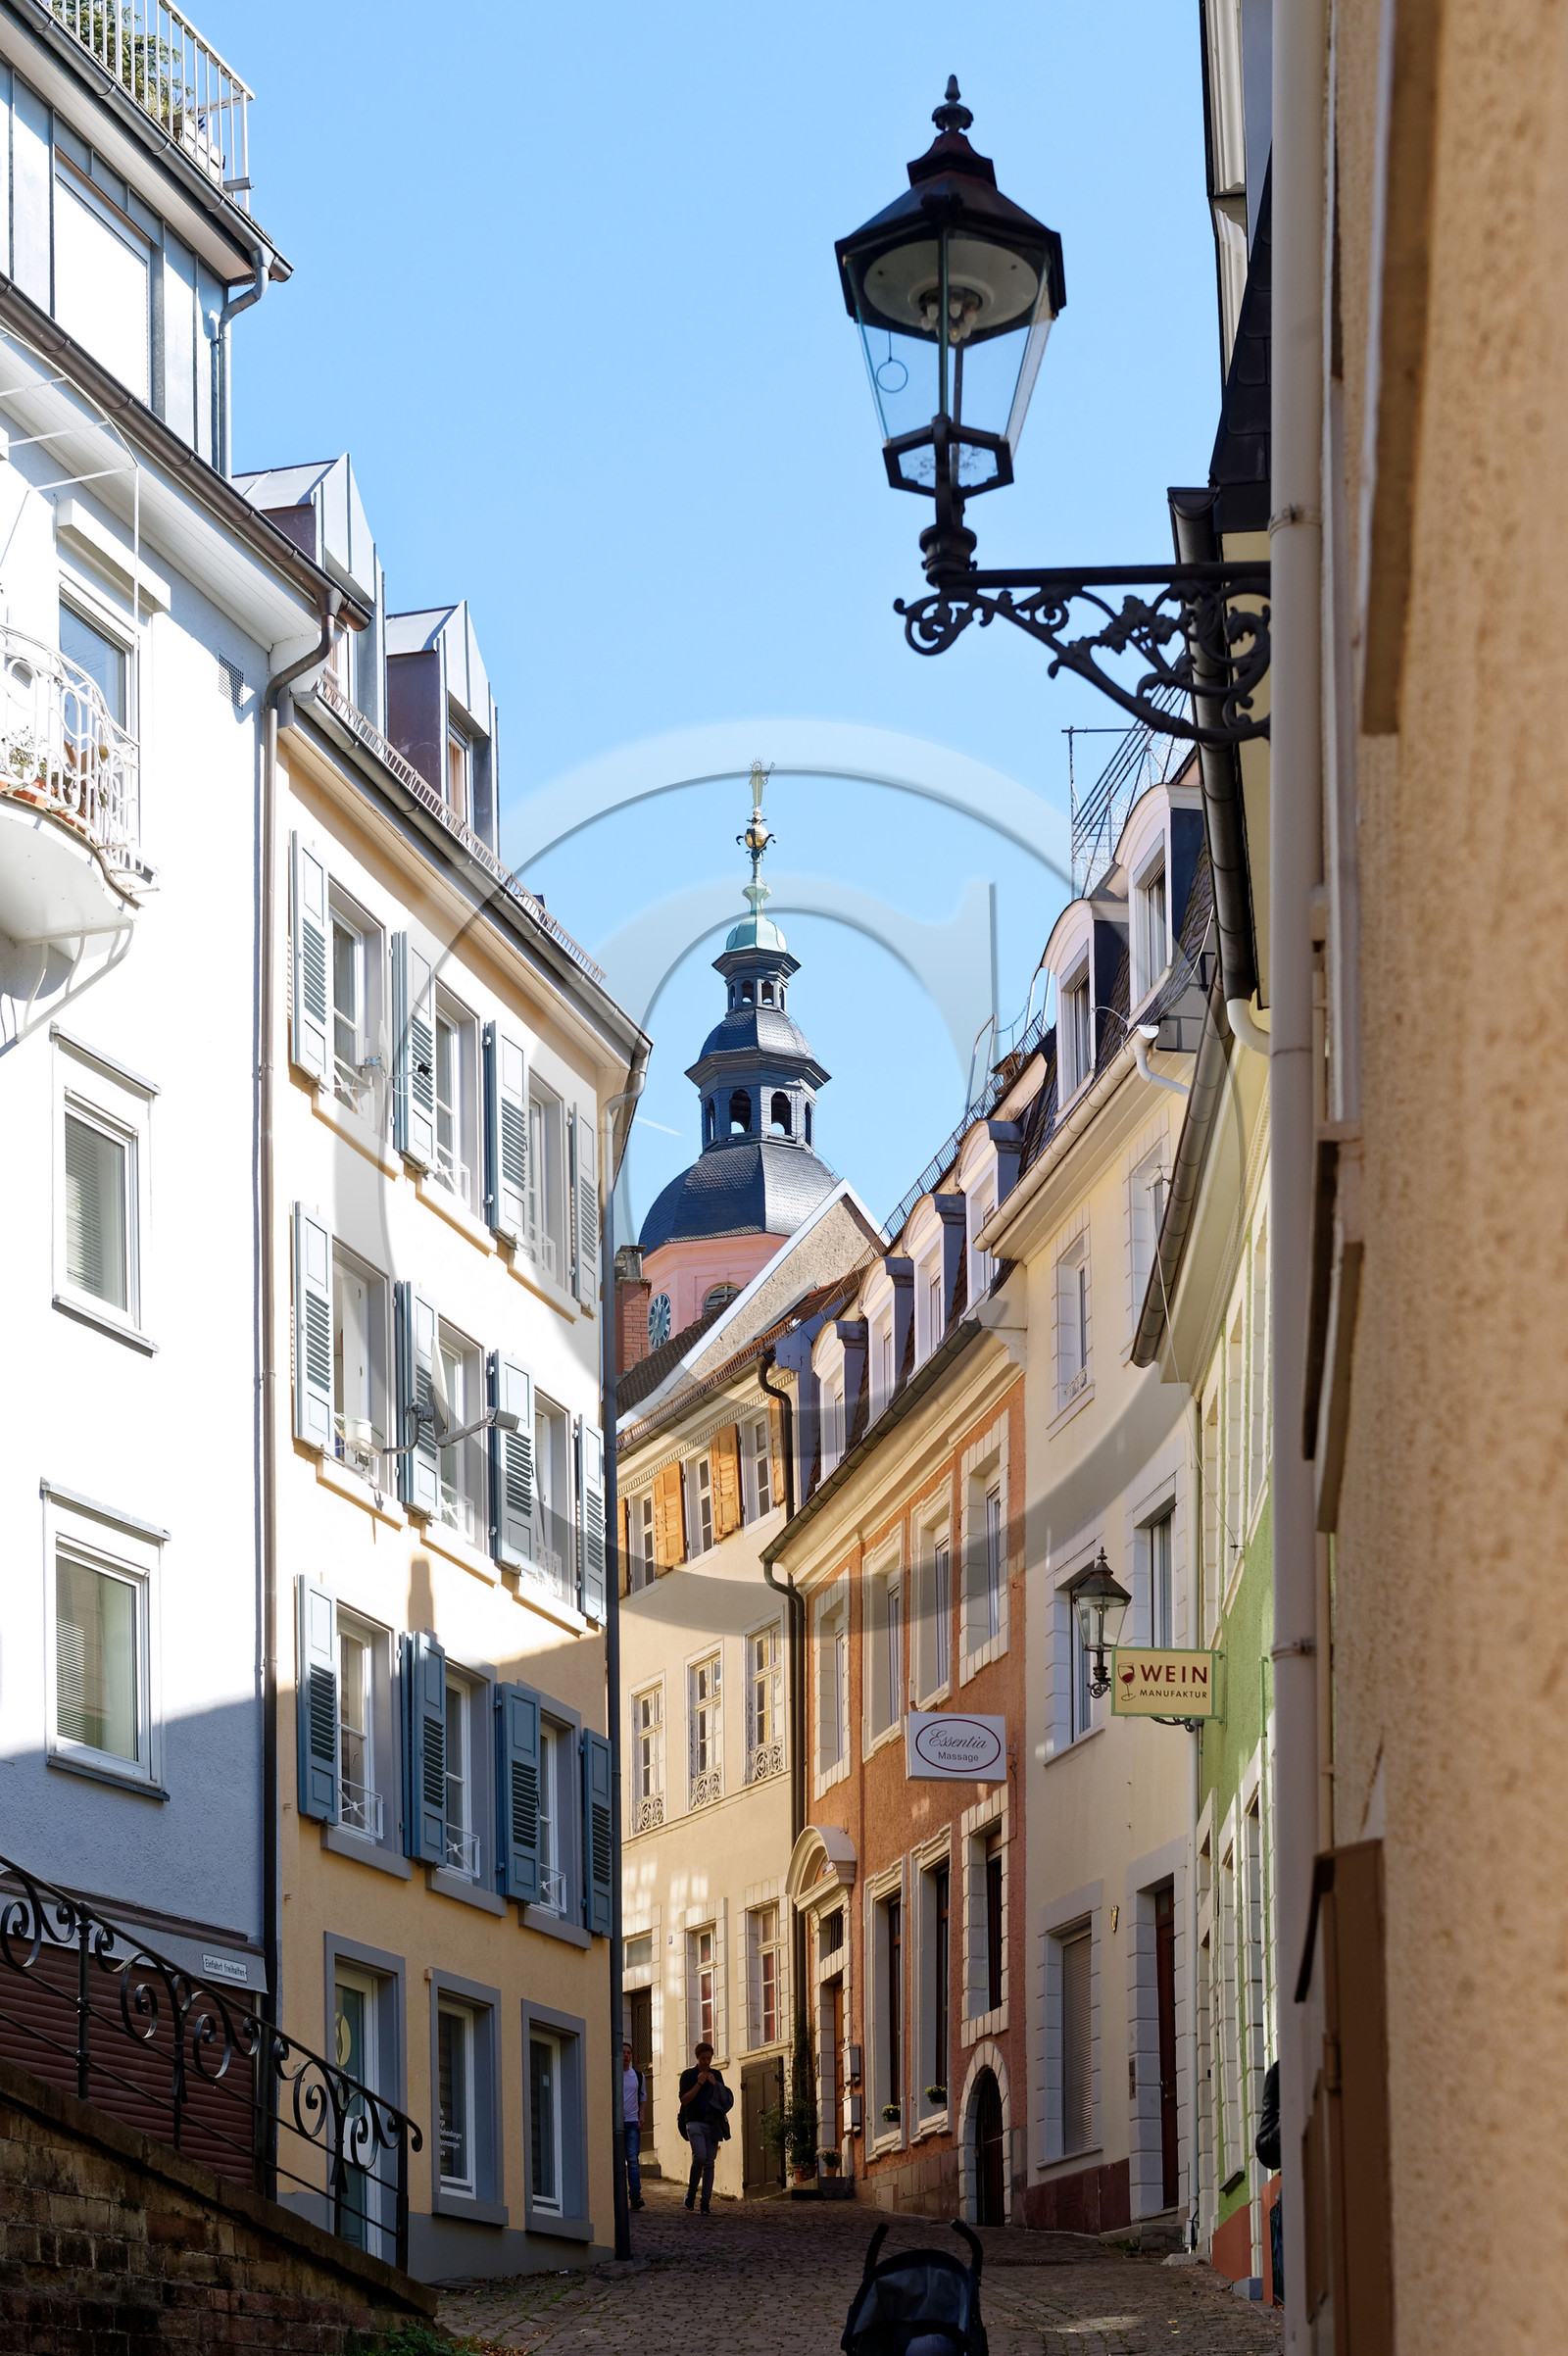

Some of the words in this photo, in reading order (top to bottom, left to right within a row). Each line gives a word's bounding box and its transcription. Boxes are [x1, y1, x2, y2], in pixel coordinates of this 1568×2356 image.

[1140, 1664, 1207, 1684] WEIN
[1139, 1689, 1207, 1699] MANUFAKTUR
[928, 1728, 988, 1749] Essentia
[938, 1751, 979, 1763] Massage
